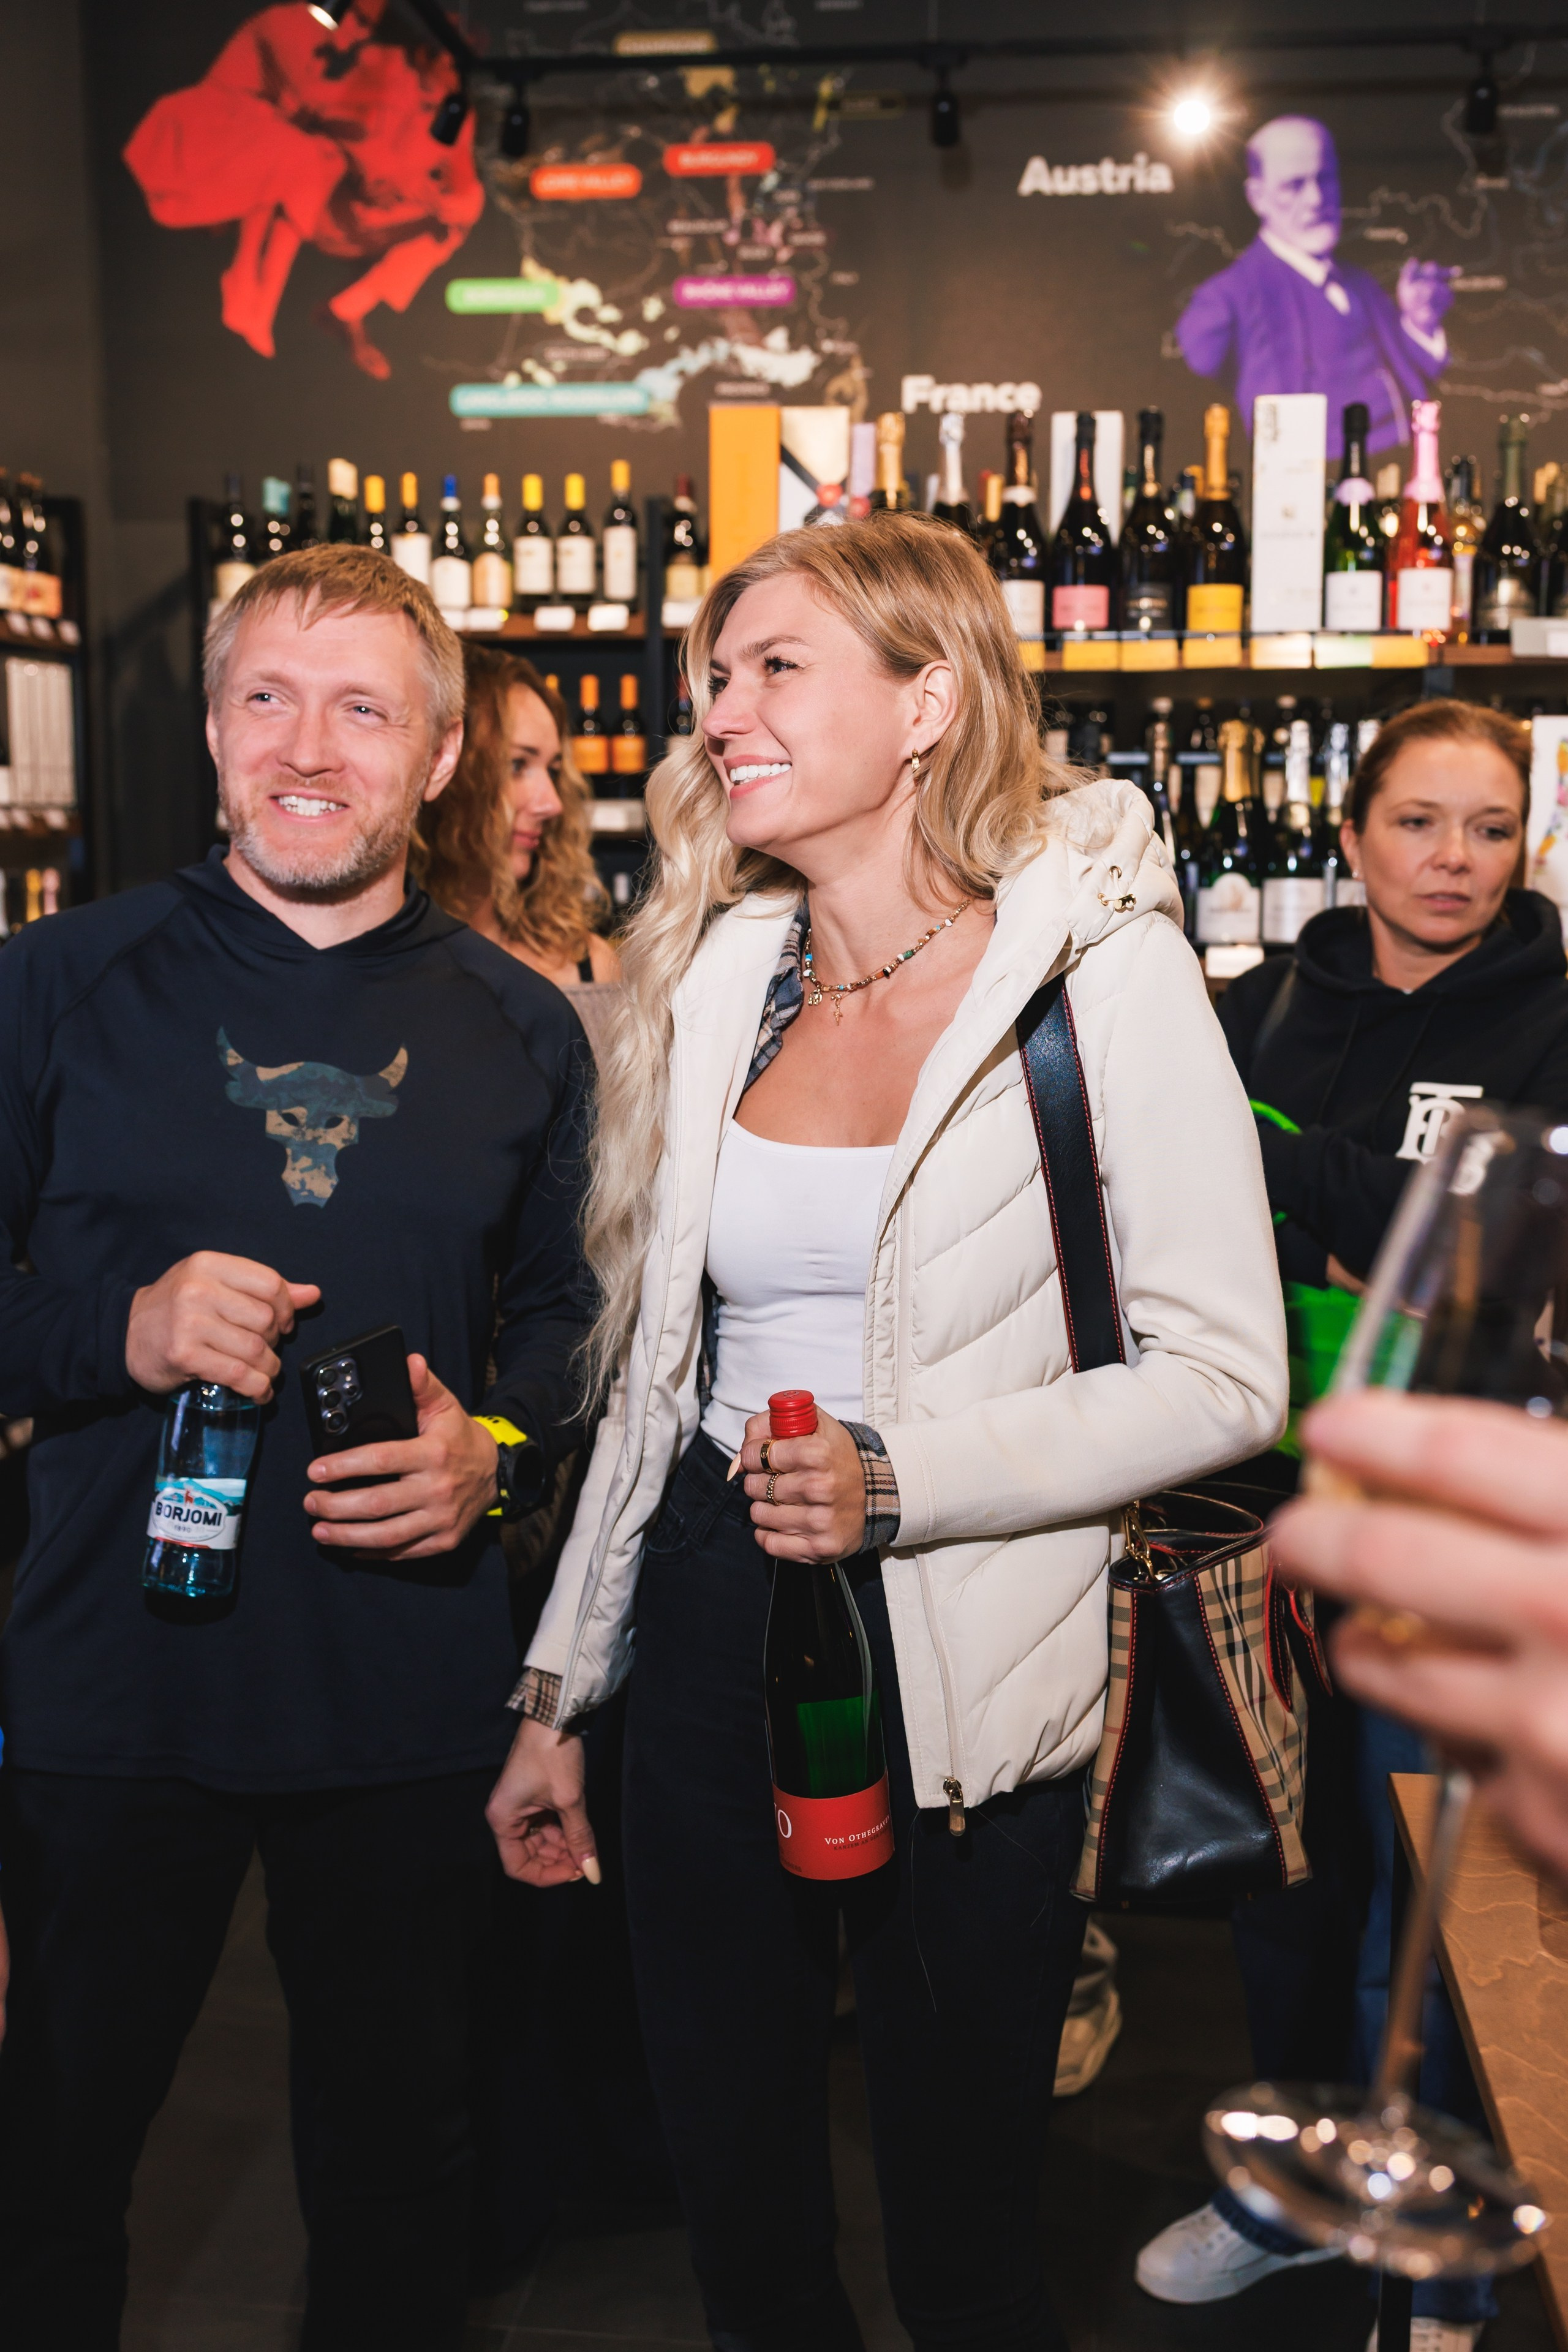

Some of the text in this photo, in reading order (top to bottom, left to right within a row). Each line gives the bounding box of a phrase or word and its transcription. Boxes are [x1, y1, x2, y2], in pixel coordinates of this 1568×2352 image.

[1019, 153, 1172, 197] Austria
[902, 375, 1041, 414] France
[156, 1501, 222, 1526] BORJOMI
[774, 1803, 792, 1838] O
